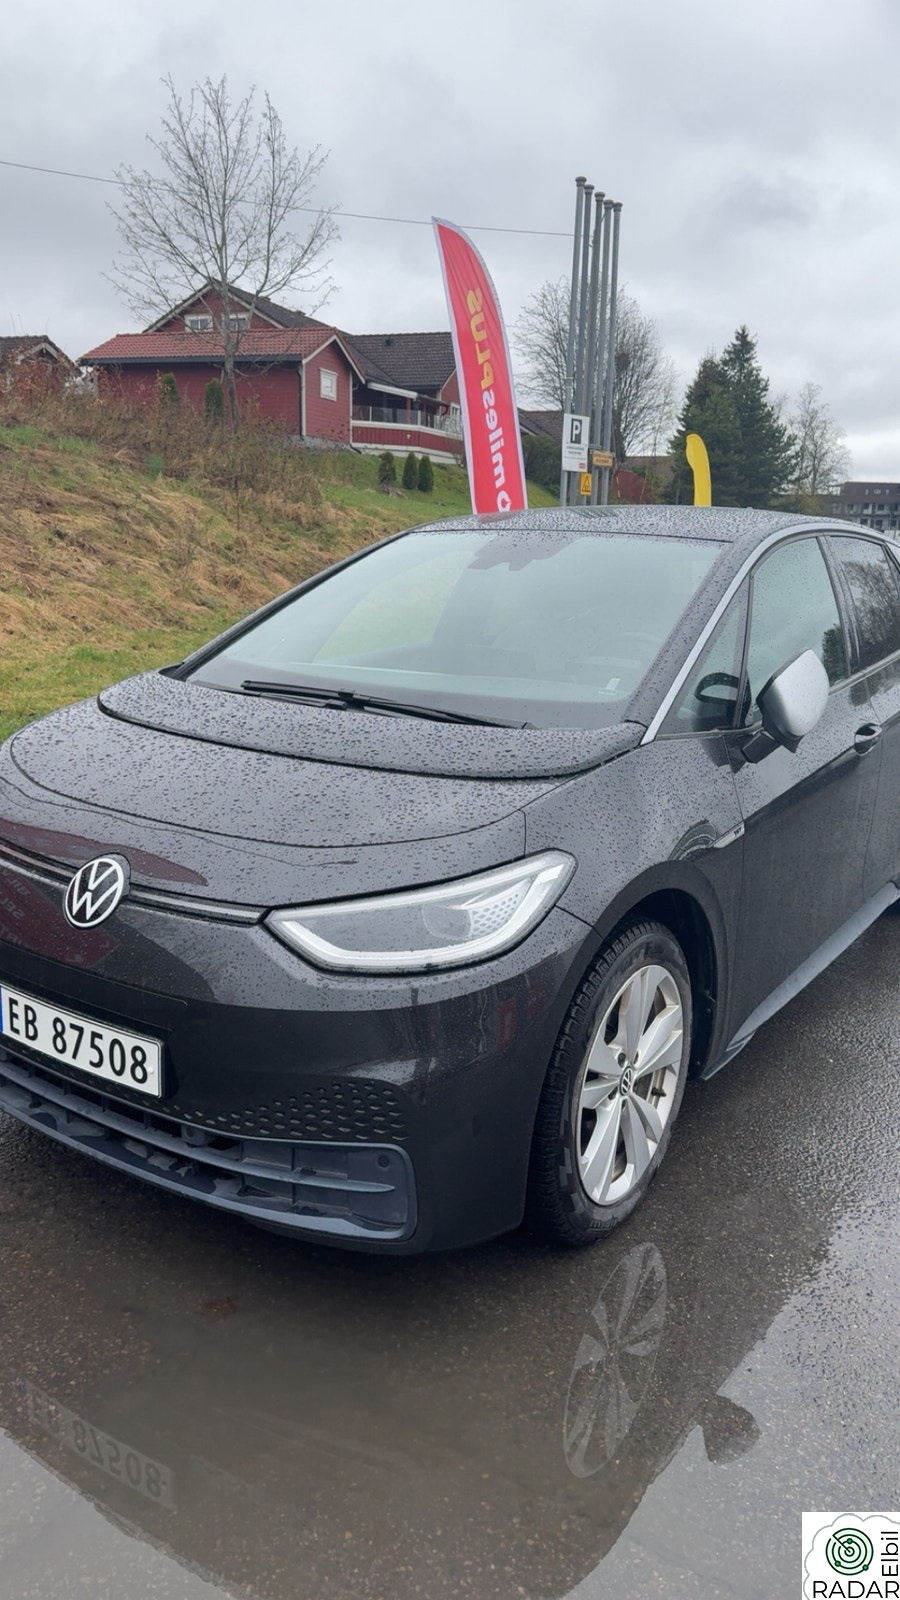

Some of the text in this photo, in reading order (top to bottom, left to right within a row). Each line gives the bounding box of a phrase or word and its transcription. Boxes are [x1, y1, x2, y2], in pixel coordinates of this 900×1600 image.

[572, 421, 581, 442] P
[8, 997, 148, 1084] EB 87508
